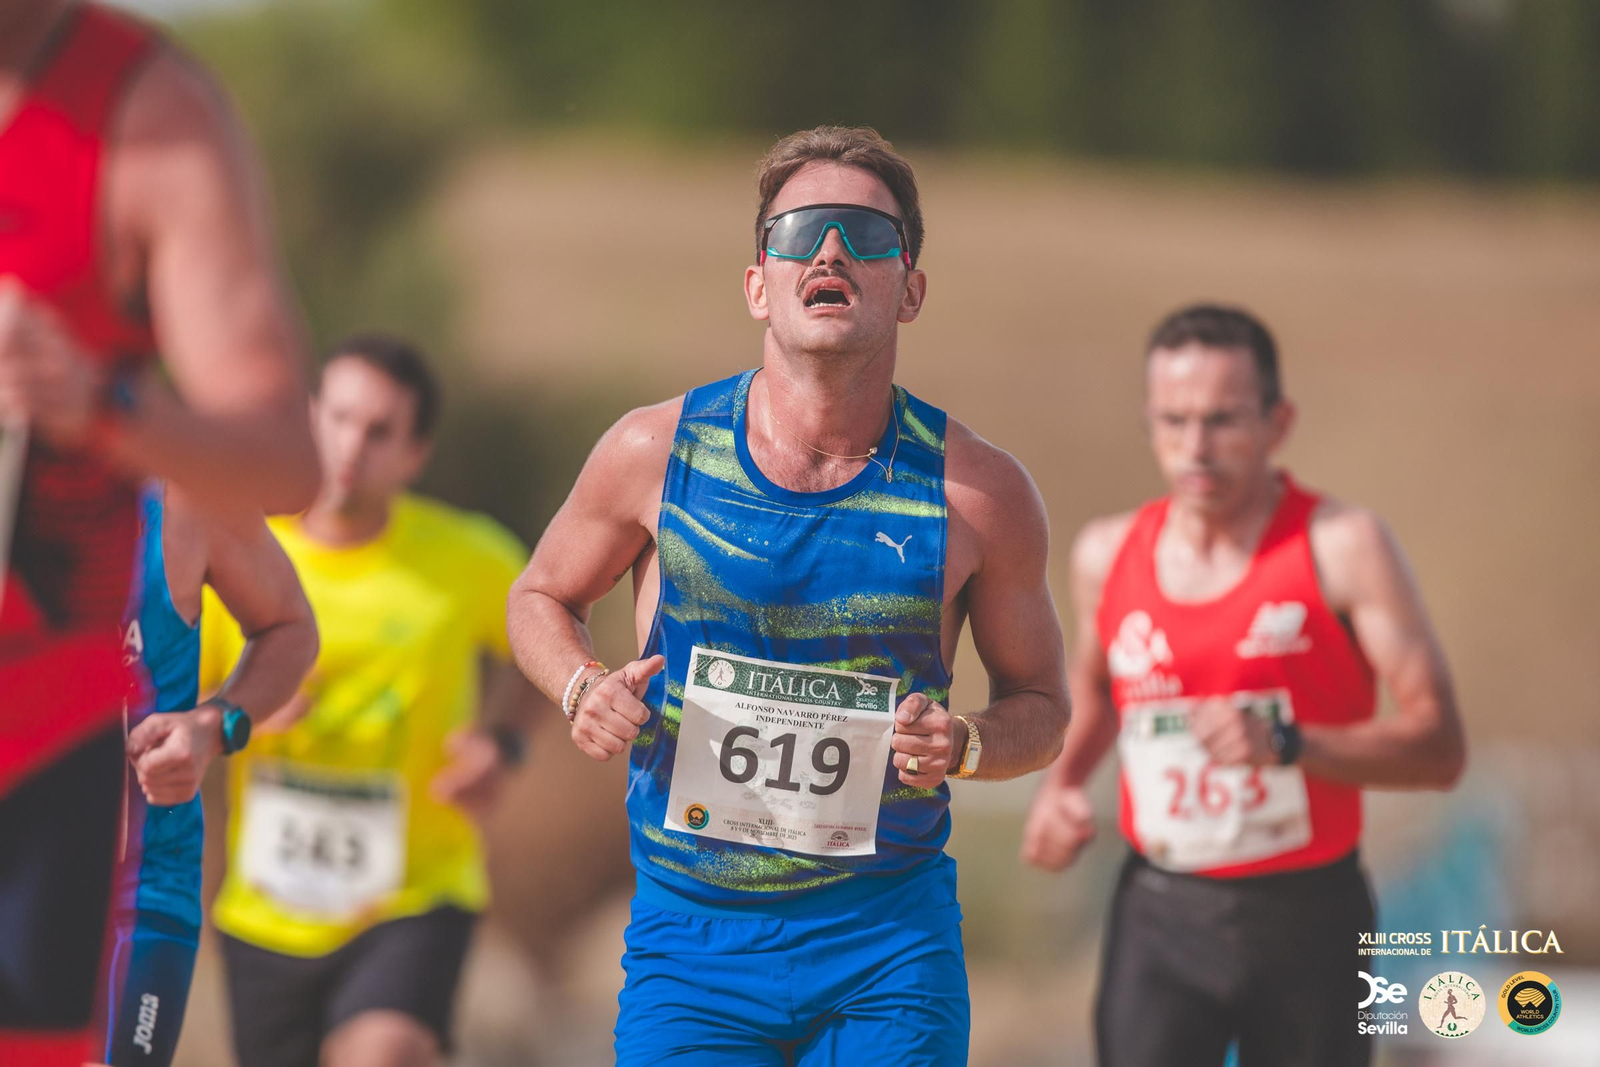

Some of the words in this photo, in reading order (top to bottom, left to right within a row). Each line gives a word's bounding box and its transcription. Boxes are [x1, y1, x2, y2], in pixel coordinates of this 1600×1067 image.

[746, 670, 842, 701] ITÁLICA
[745, 690, 793, 702] INTERNATIONAL
[735, 702, 775, 714] ALFONSO
[776, 708, 819, 720] NAVARRO
[820, 712, 849, 723] PÉREZ
[855, 701, 878, 710] Sevilla
[755, 714, 825, 730] INDEPENDIENTE
[719, 725, 851, 796] 619
[723, 819, 739, 827] CROSS
[739, 821, 780, 832] INTERNACIONAL
